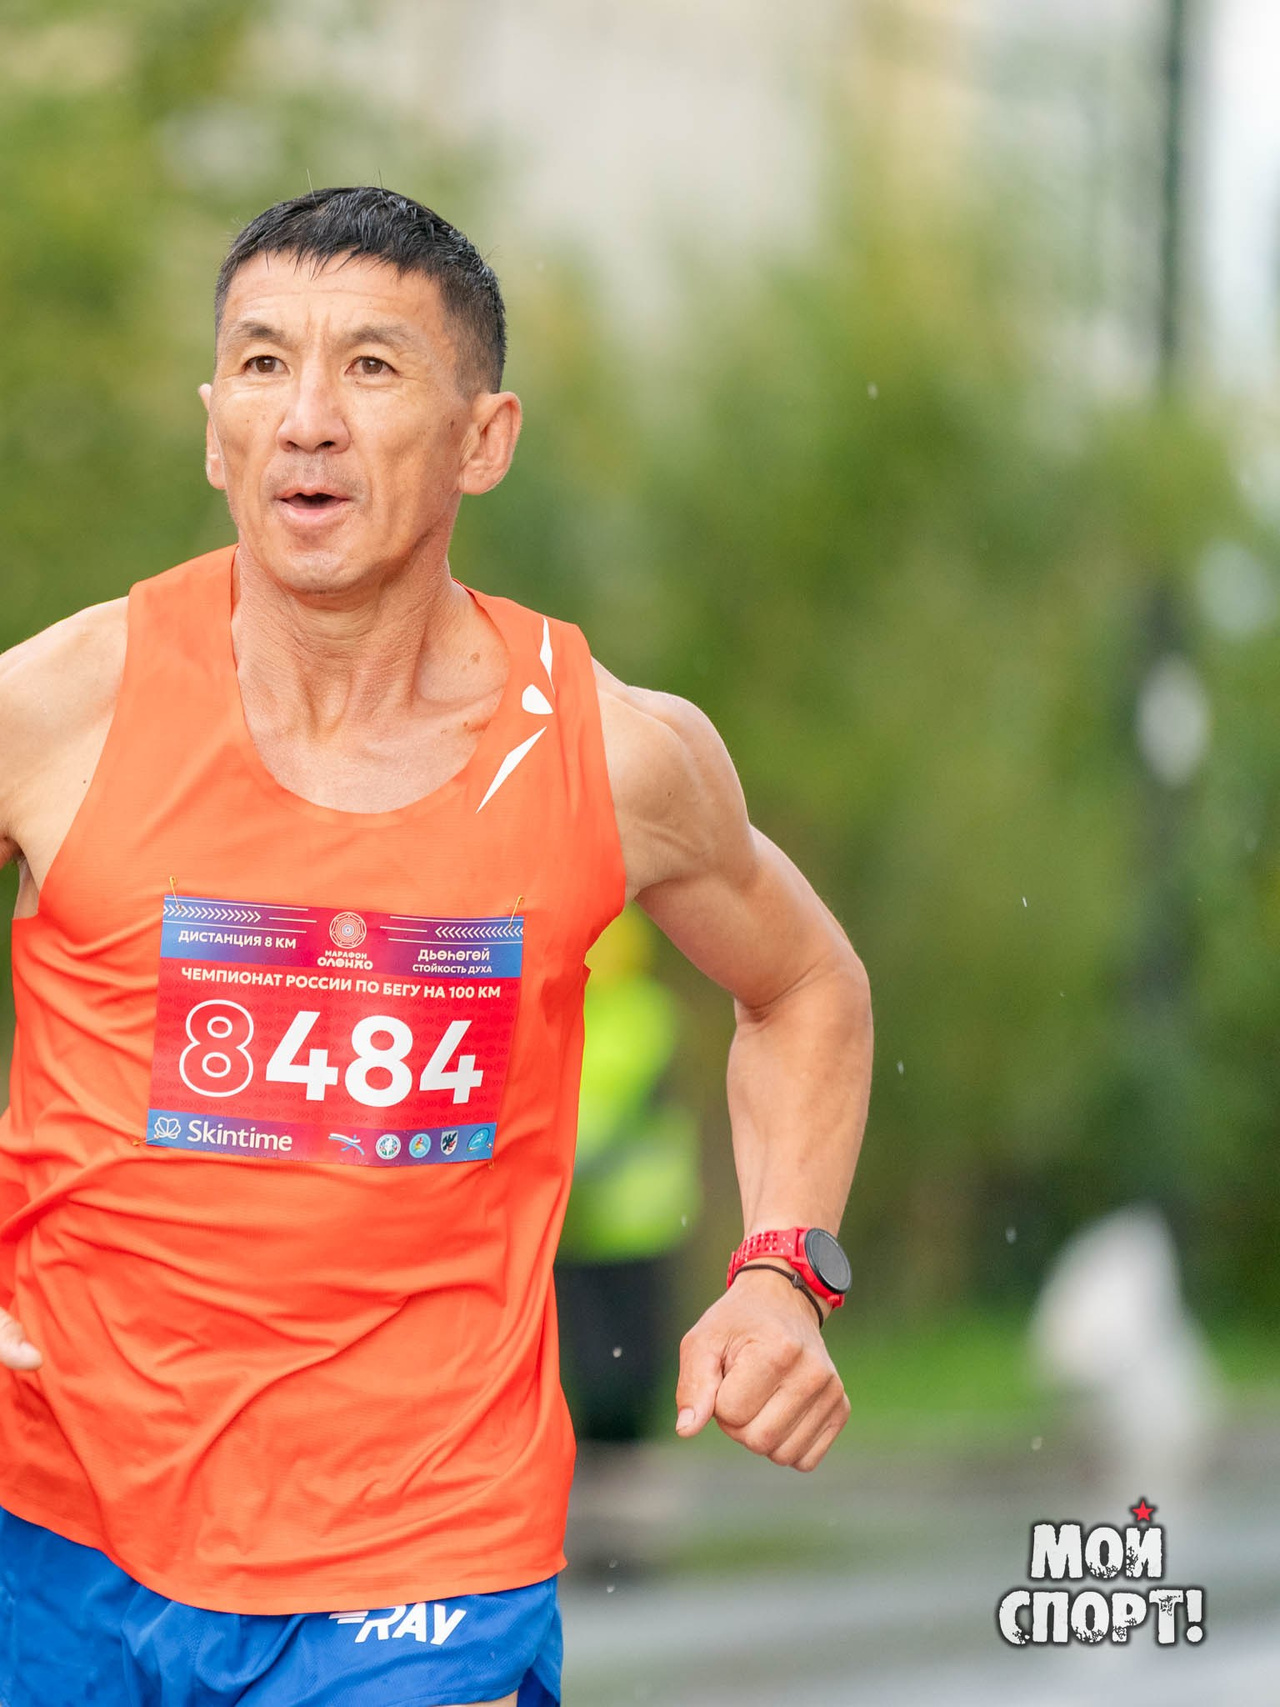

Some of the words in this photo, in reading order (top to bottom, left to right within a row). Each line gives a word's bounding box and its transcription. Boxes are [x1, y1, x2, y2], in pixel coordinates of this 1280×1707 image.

[178, 930, 262, 947] ДИСТАНЦИЯ
[264, 939, 272, 947] 8
[275, 938, 297, 949] КМ
[325, 950, 368, 960] МАРАФОН
[412, 963, 466, 974] СТОЙКОСТЬ
[468, 965, 493, 974] ДУХА
[181, 967, 283, 987] ЧЕМПИОНАТ
[286, 975, 352, 991] РОССИИ
[356, 980, 379, 994] ПО
[383, 982, 421, 998] БЕГУ
[423, 985, 446, 998] НА
[449, 987, 475, 998] 100
[478, 986, 501, 998] КМ
[179, 999, 484, 1107] 8484
[186, 1119, 293, 1152] Skintime
